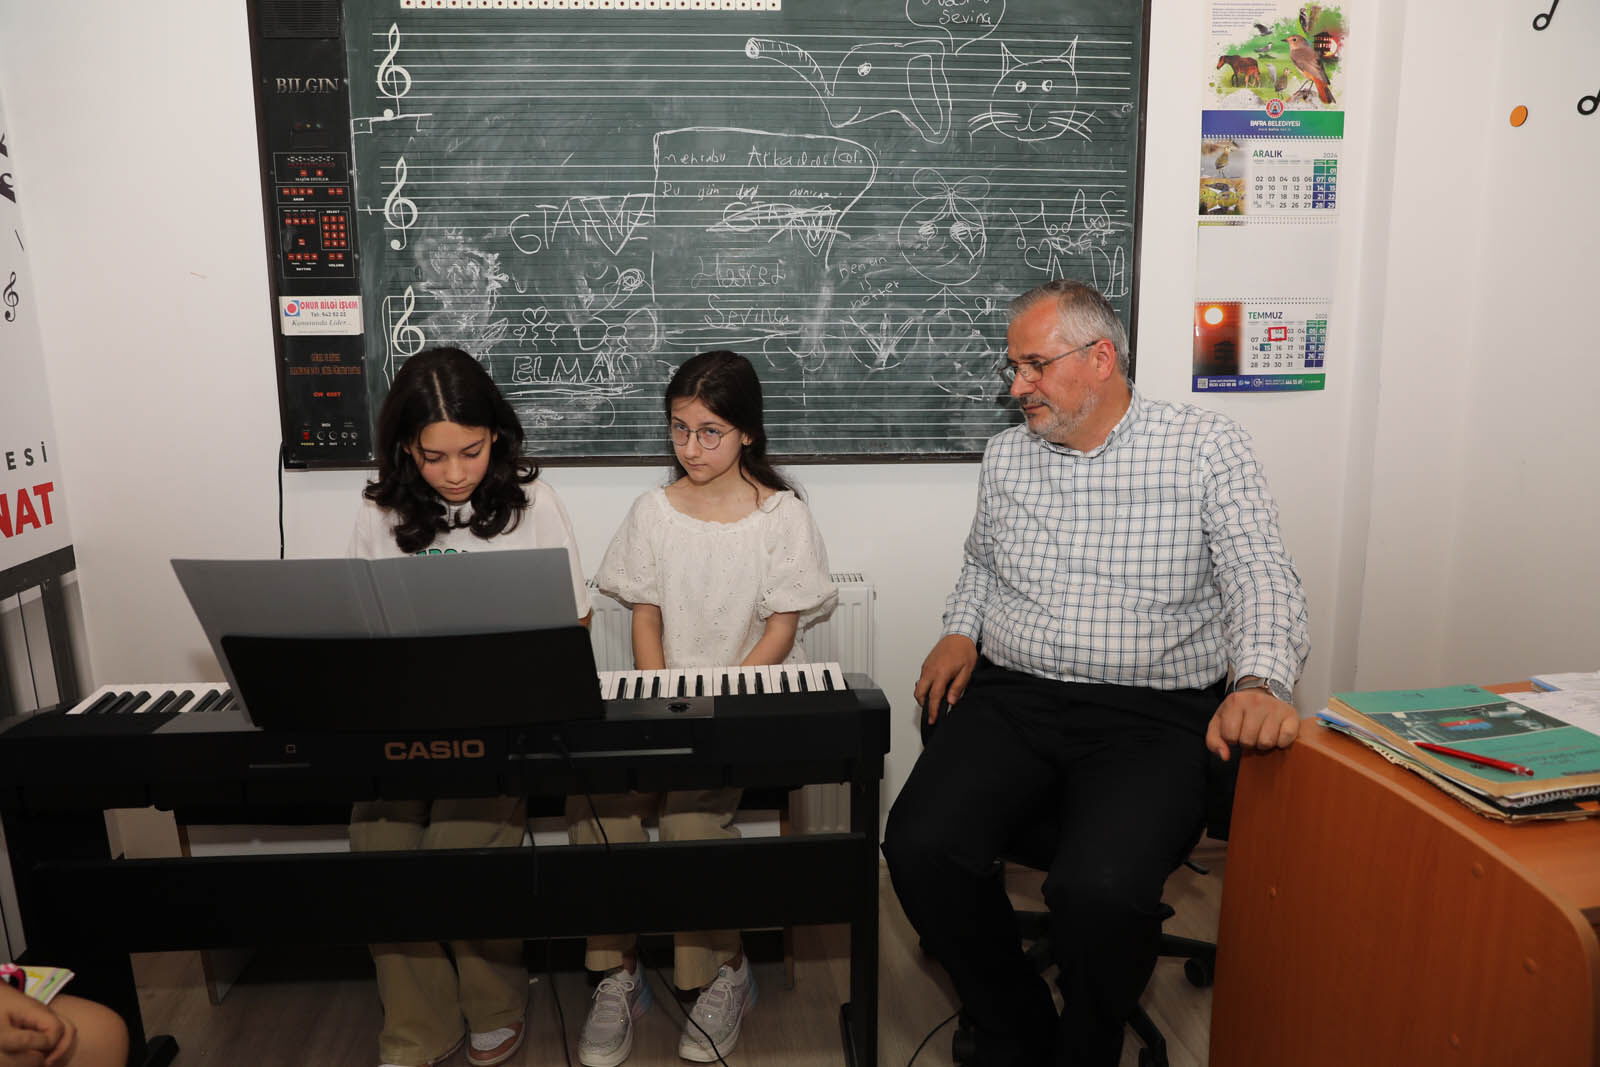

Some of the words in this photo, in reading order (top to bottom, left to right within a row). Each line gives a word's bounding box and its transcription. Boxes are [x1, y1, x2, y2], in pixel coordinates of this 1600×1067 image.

[1253, 150, 1283, 158] ARALIK
[300, 302, 319, 310] ONUR
[1248, 312, 1283, 320] TEMMUZ
[384, 739, 485, 761] CASIO
